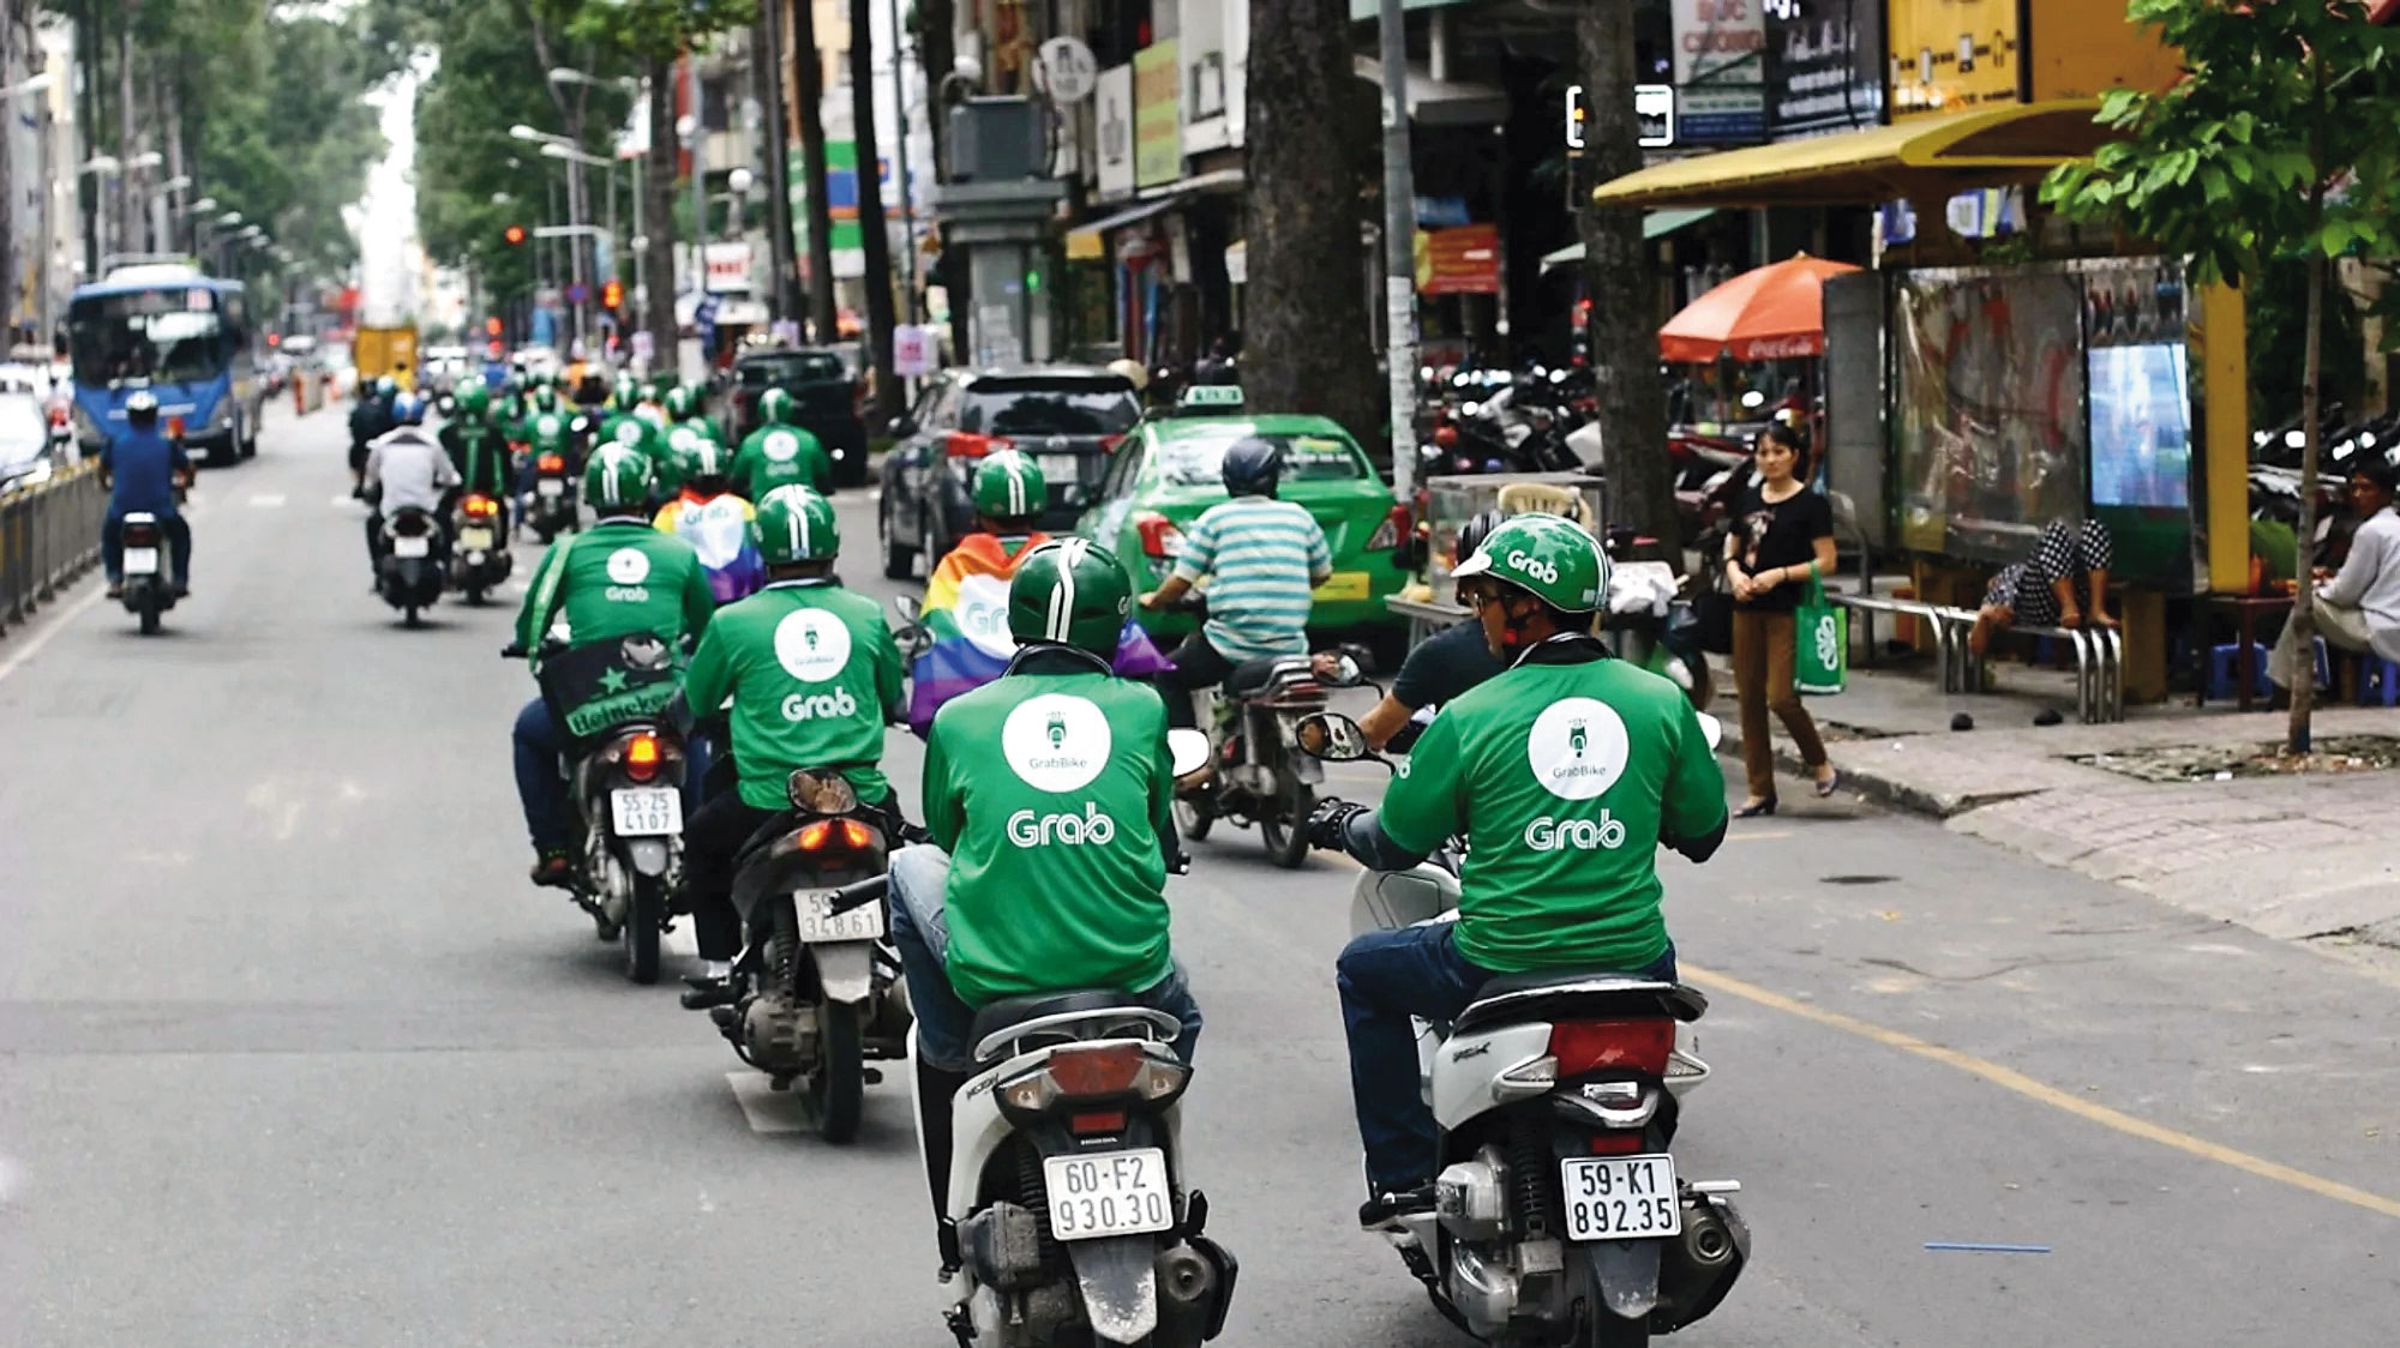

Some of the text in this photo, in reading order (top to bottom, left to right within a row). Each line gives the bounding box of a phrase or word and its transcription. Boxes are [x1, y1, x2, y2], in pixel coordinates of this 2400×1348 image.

[1507, 549, 1559, 585] Grab
[605, 585, 650, 602] Grab
[962, 602, 1007, 636] Gr
[781, 685, 856, 722] Grab
[1029, 757, 1088, 770] GrabBike
[1553, 766, 1606, 779] GrabBike
[1007, 801, 1116, 849] Grab
[1524, 808, 1626, 851] Grab
[1066, 1157, 1147, 1194] 60-F2
[1580, 1162, 1655, 1196] 59-K1
[1060, 1192, 1162, 1232] 930.30
[1574, 1197, 1673, 1234] 892.35
